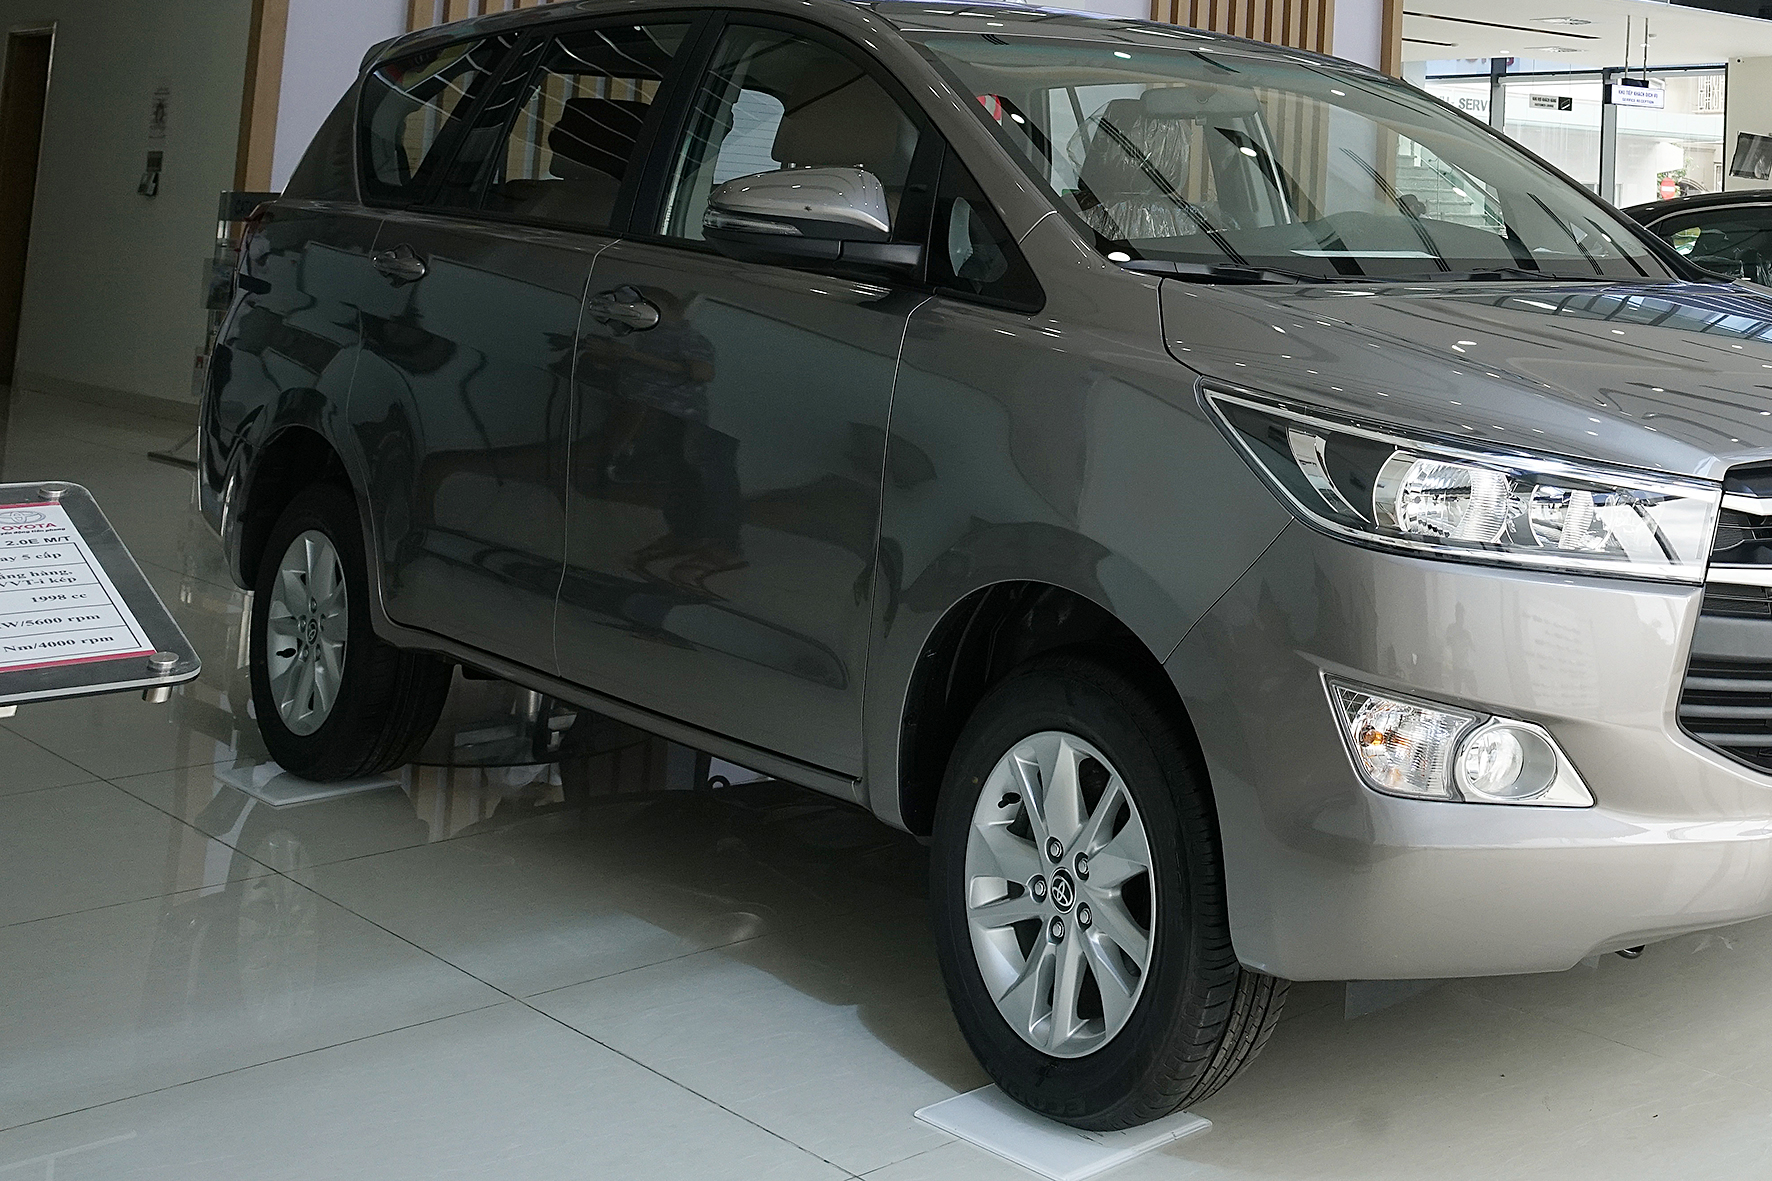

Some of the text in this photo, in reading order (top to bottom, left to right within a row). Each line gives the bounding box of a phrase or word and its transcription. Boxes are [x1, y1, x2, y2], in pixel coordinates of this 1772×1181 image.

[0, 522, 57, 531] OYOTA
[5, 535, 71, 547] 2.0E M/T
[31, 592, 88, 603] 1998 cc
[0, 614, 101, 629] W/5600 rpm
[3, 635, 115, 653] Nm/4000 rpm
